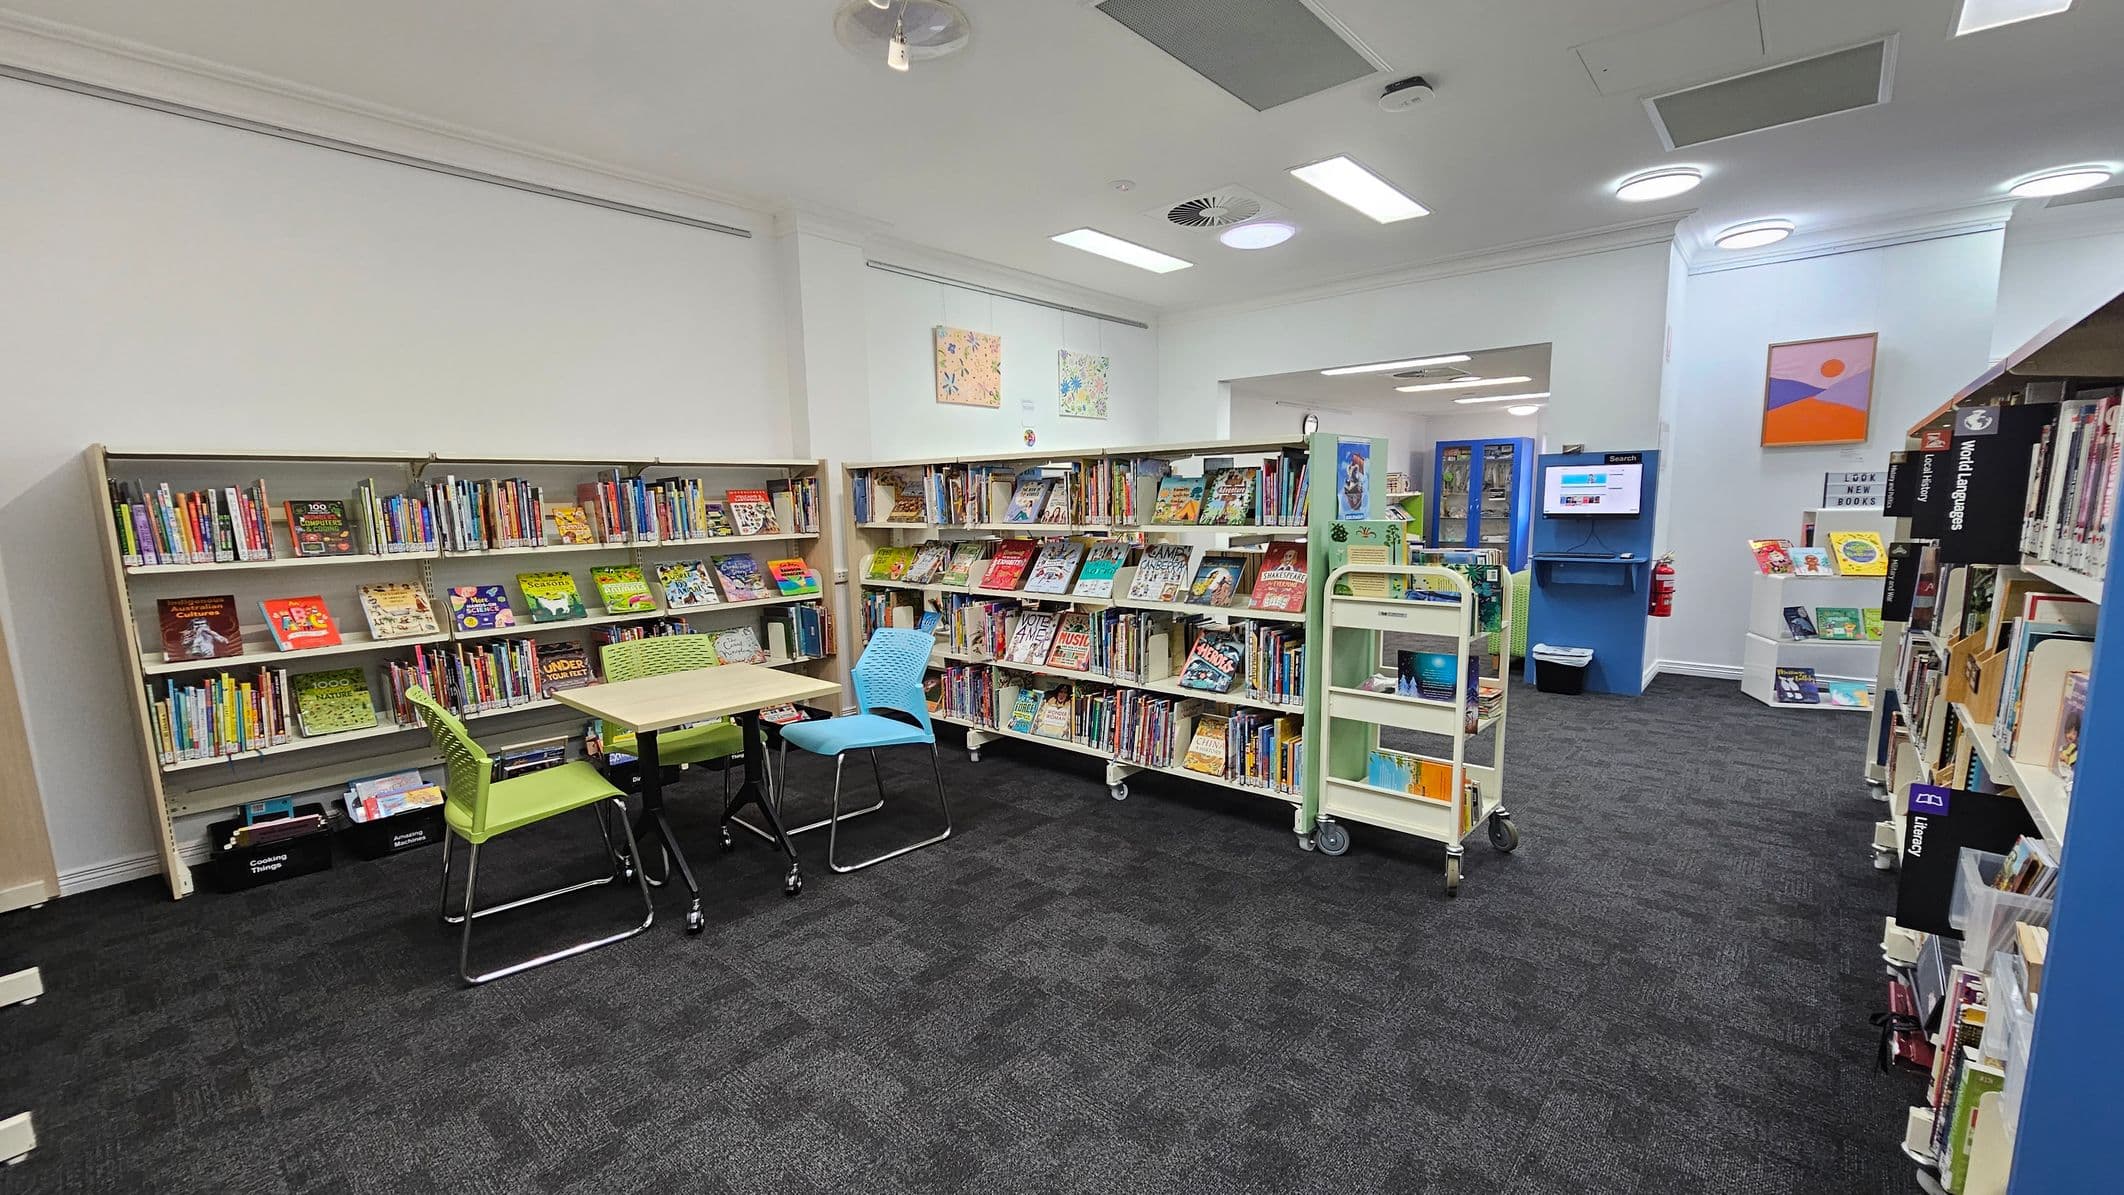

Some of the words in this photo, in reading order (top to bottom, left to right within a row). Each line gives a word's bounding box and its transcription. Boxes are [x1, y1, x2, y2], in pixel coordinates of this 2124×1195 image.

[1958, 440, 1976, 471] World
[1922, 453, 1935, 474] Local
[1845, 473, 1876, 482] LOOK
[1888, 465, 1898, 481] History
[1218, 486, 1246, 494] Adventure
[1847, 486, 1871, 494] NEW
[1917, 475, 1933, 502] History
[1838, 498, 1876, 506] BOOKS
[1949, 473, 1972, 530] Languages
[1148, 545, 1185, 560] CAMP
[1141, 559, 1186, 573] CANBERRA
[1263, 571, 1307, 582] SHAKESPEARE
[527, 579, 570, 588] Seasons
[167, 597, 225, 606] Indigenous
[170, 604, 224, 612] Australian
[466, 606, 500, 614] SCIENCE
[1020, 613, 1050, 627] VOTE
[1016, 627, 1027, 644] 4
[1058, 632, 1090, 645] MUSIC
[1197, 643, 1235, 673] HEROES
[543, 659, 585, 674] UNDER
[547, 671, 569, 681] YOUR
[570, 669, 588, 678] FEET
[311, 679, 350, 689] 1000
[316, 690, 353, 700] NATURE
[392, 830, 424, 842] Amazing
[393, 835, 427, 847] Machines
[1907, 816, 1928, 857] Literacy
[249, 853, 288, 867] Cooking
[250, 862, 283, 874] Things
